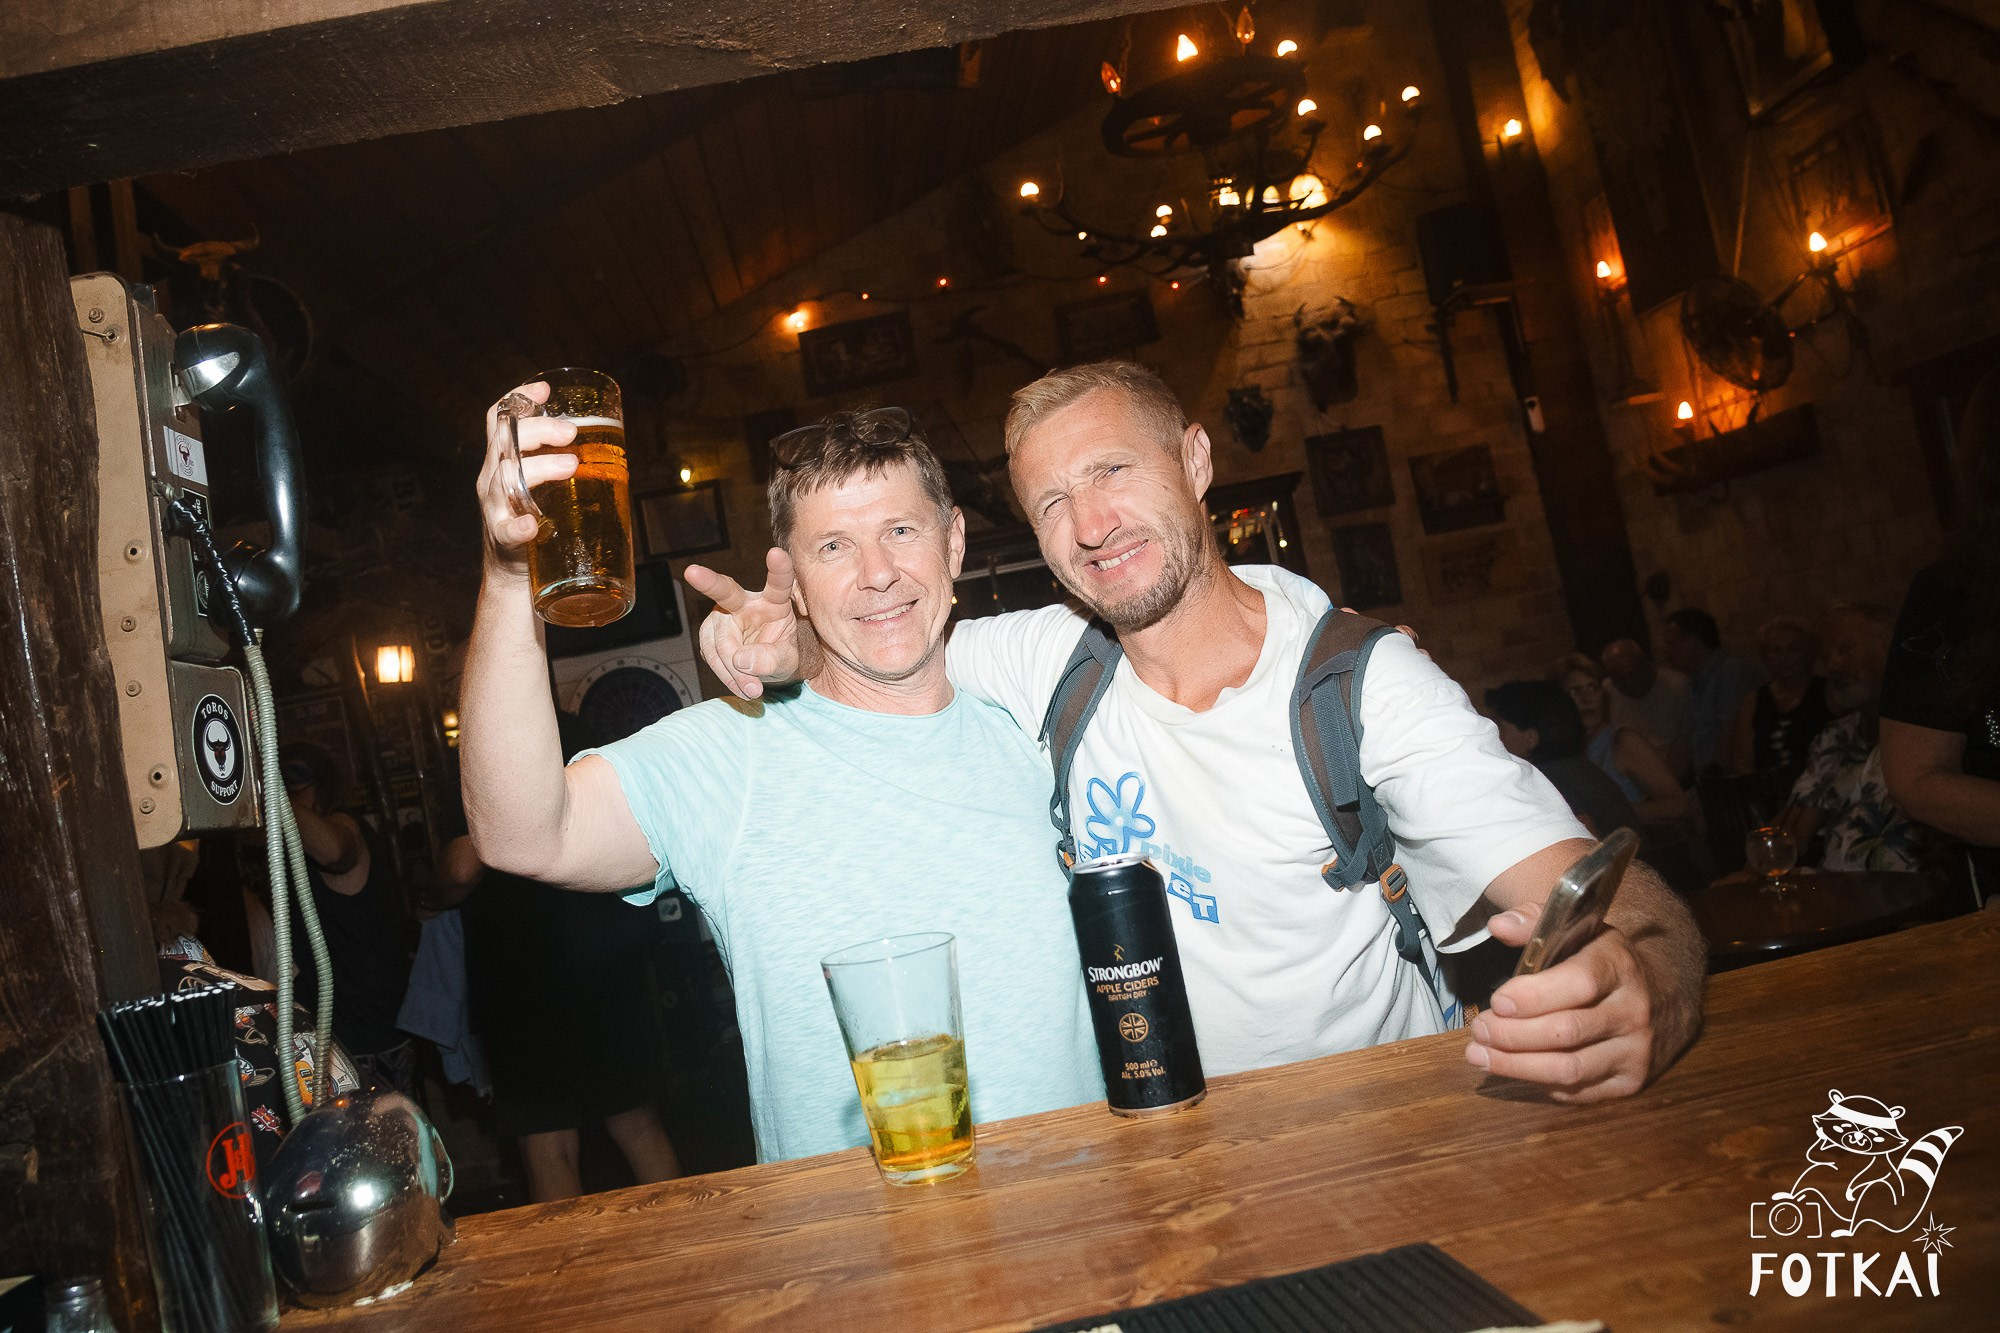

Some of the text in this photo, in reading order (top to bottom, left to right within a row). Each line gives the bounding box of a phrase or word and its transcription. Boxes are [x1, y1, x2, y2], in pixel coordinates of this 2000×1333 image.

[201, 702, 229, 720] TOROS
[211, 780, 238, 797] SUPPORT
[1141, 841, 1212, 884] pixie
[1088, 957, 1162, 983] STRONGBOW
[1096, 976, 1160, 993] APPLE CIDERS
[1133, 990, 1147, 999] DRY
[1125, 1062, 1139, 1071] 500
[1134, 1069, 1151, 1079] 5.0%
